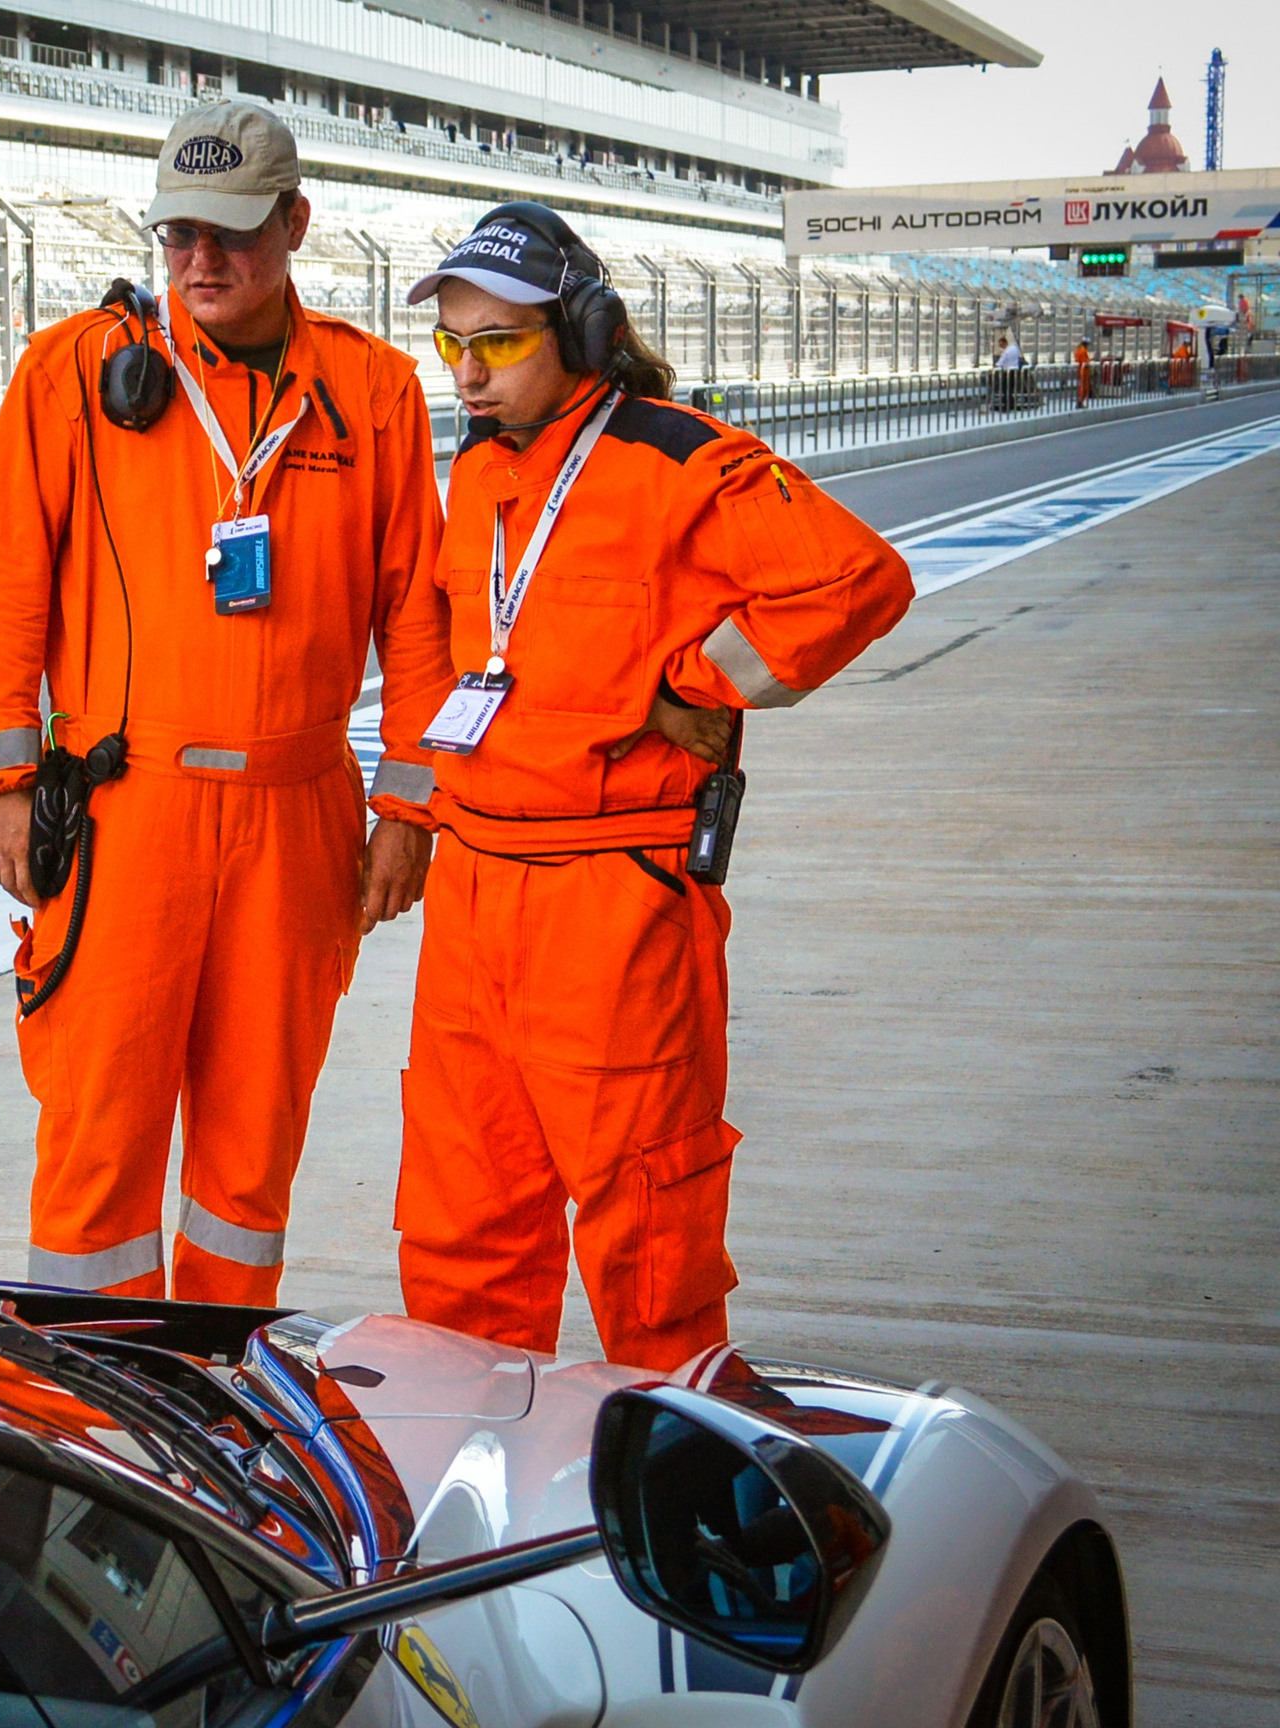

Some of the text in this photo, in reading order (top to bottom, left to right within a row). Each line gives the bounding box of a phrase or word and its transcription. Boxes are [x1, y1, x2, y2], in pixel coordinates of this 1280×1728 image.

[179, 141, 232, 168] NHRA
[198, 166, 228, 175] RACING
[807, 207, 1042, 233] SOCHI AUTODROM
[1092, 194, 1208, 221] ЛУКОЙЛ
[460, 225, 529, 246] NIOR
[446, 240, 522, 265] OFFICIAL
[257, 434, 280, 461] RACING
[310, 451, 356, 468] MARAL
[552, 453, 582, 505] SMP RACING
[505, 568, 528, 620] SMP RACING
